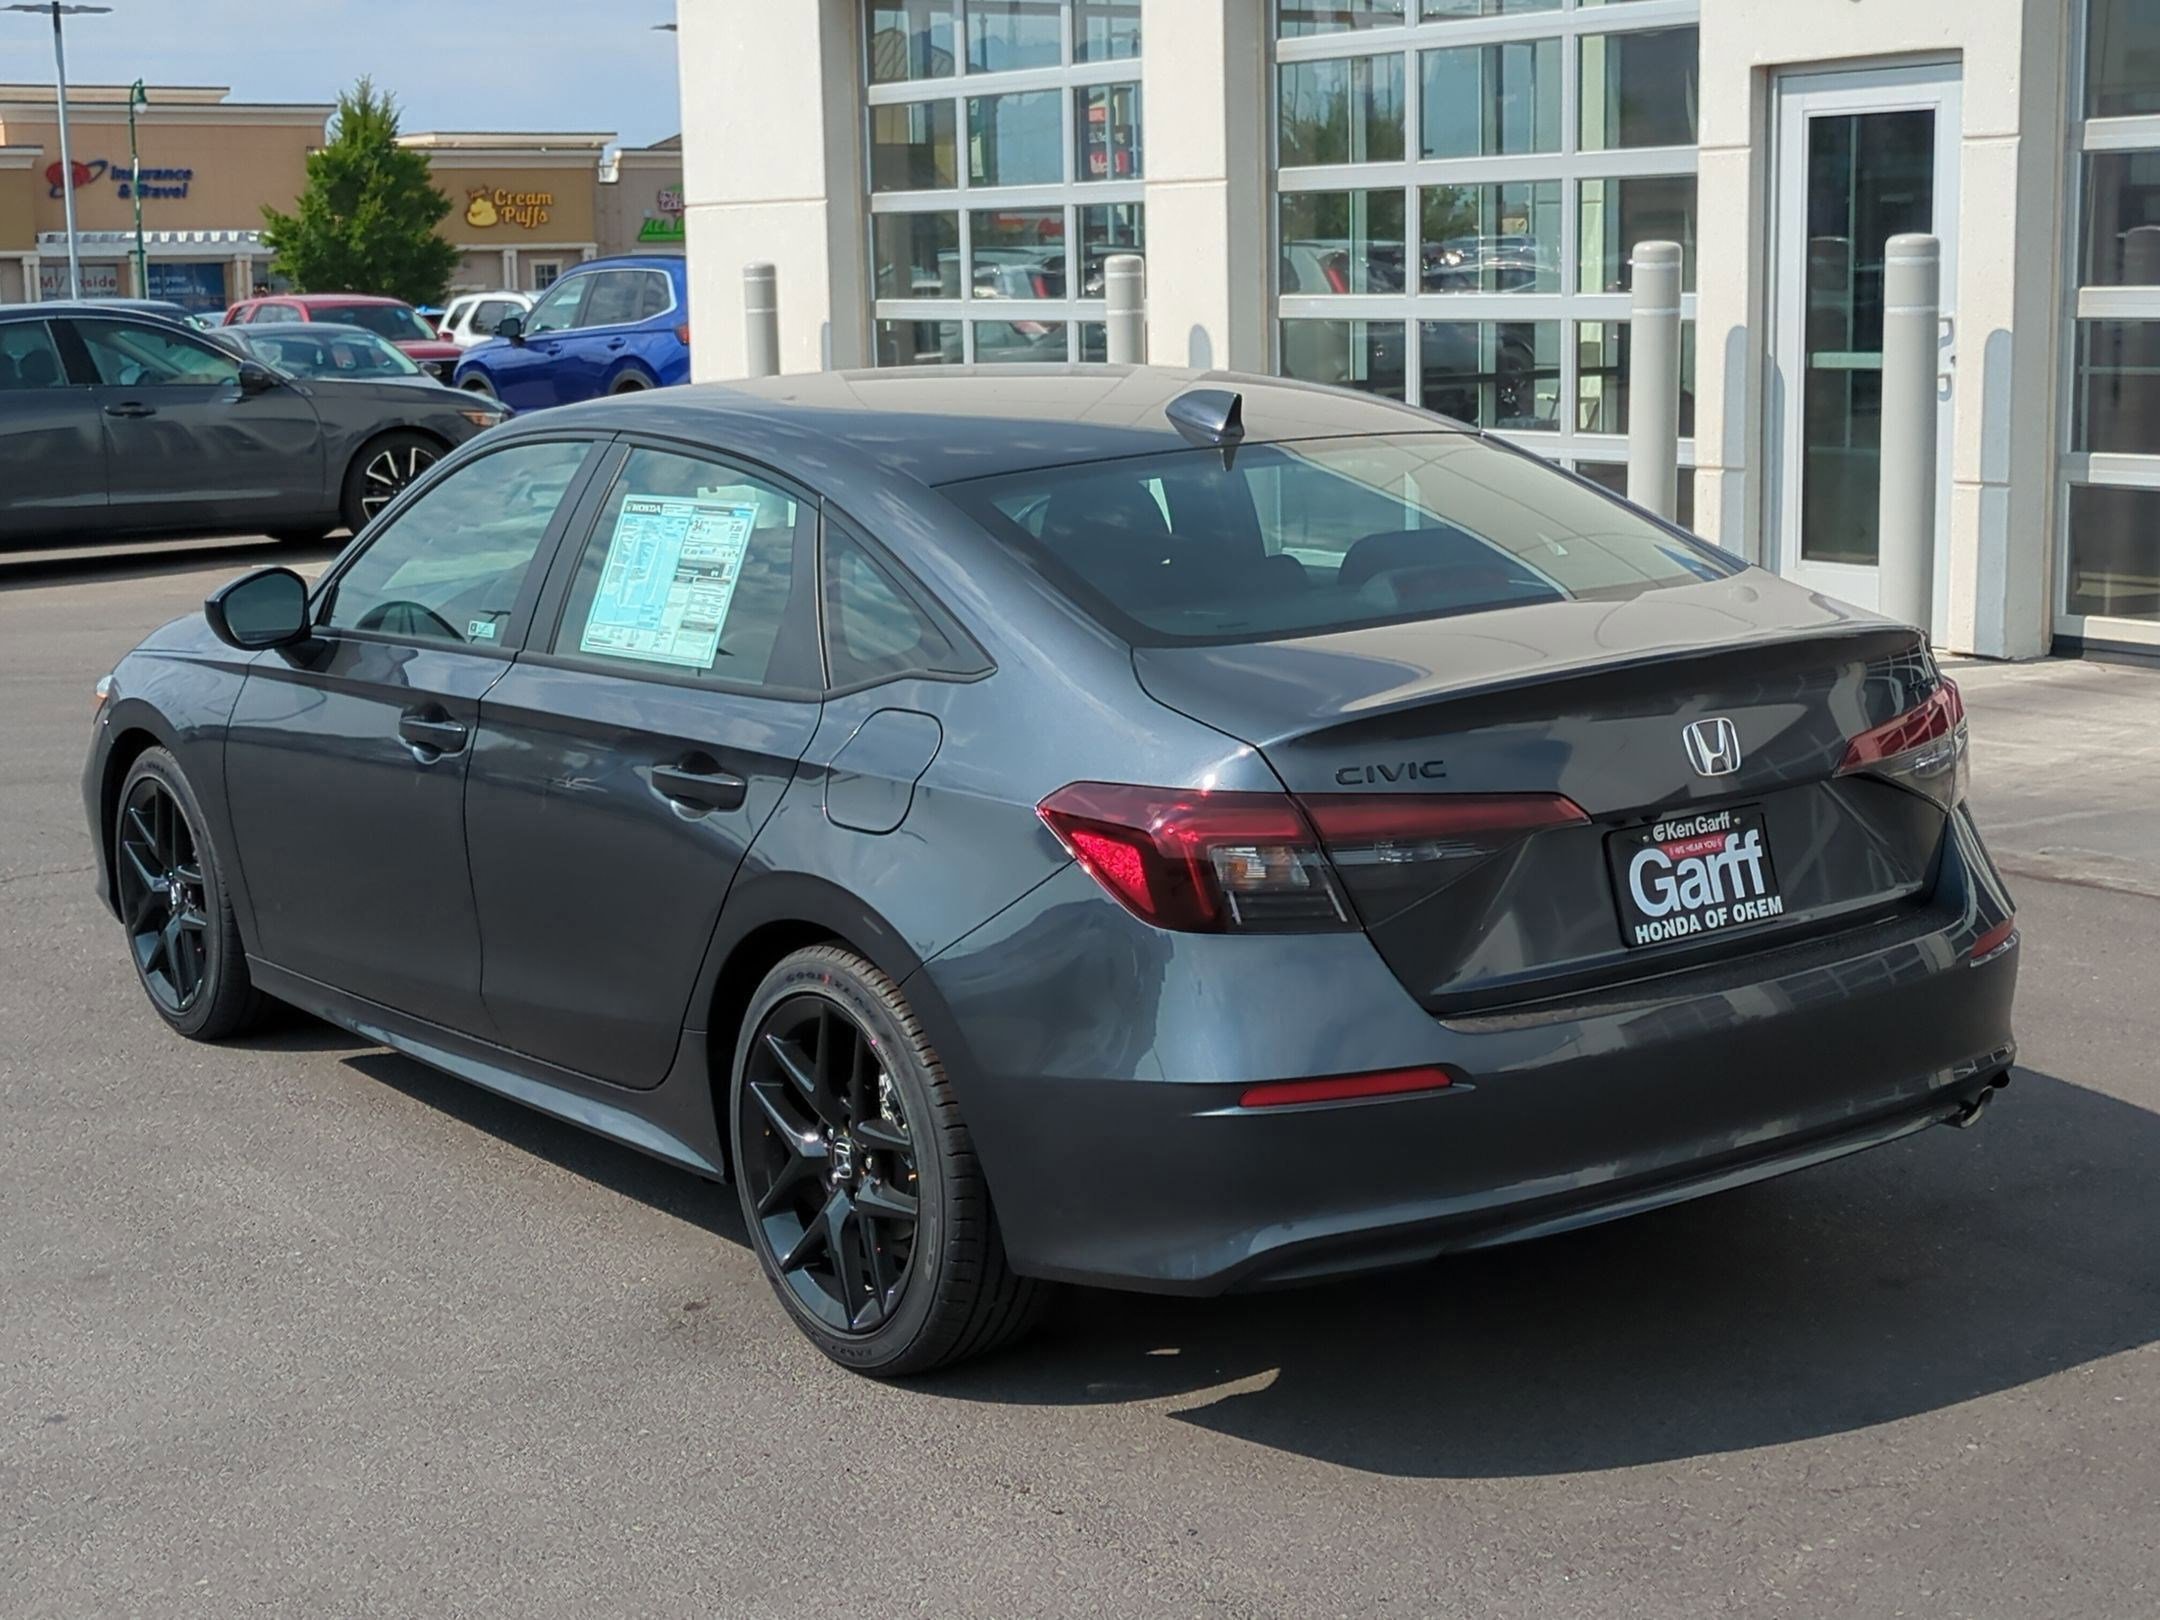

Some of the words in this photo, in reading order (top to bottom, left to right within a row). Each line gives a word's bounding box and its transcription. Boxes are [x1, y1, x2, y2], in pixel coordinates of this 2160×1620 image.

[118, 183, 131, 199] &
[494, 188, 553, 206] Cream
[501, 206, 549, 228] Puffs
[1335, 759, 1447, 786] CIVIC
[1665, 819, 1696, 841] Ken
[1695, 811, 1731, 833] Garff
[1628, 828, 1766, 918] Garff
[1634, 913, 1702, 944] HONDA
[1705, 907, 1728, 929] OF
[1733, 895, 1784, 923] OREM
